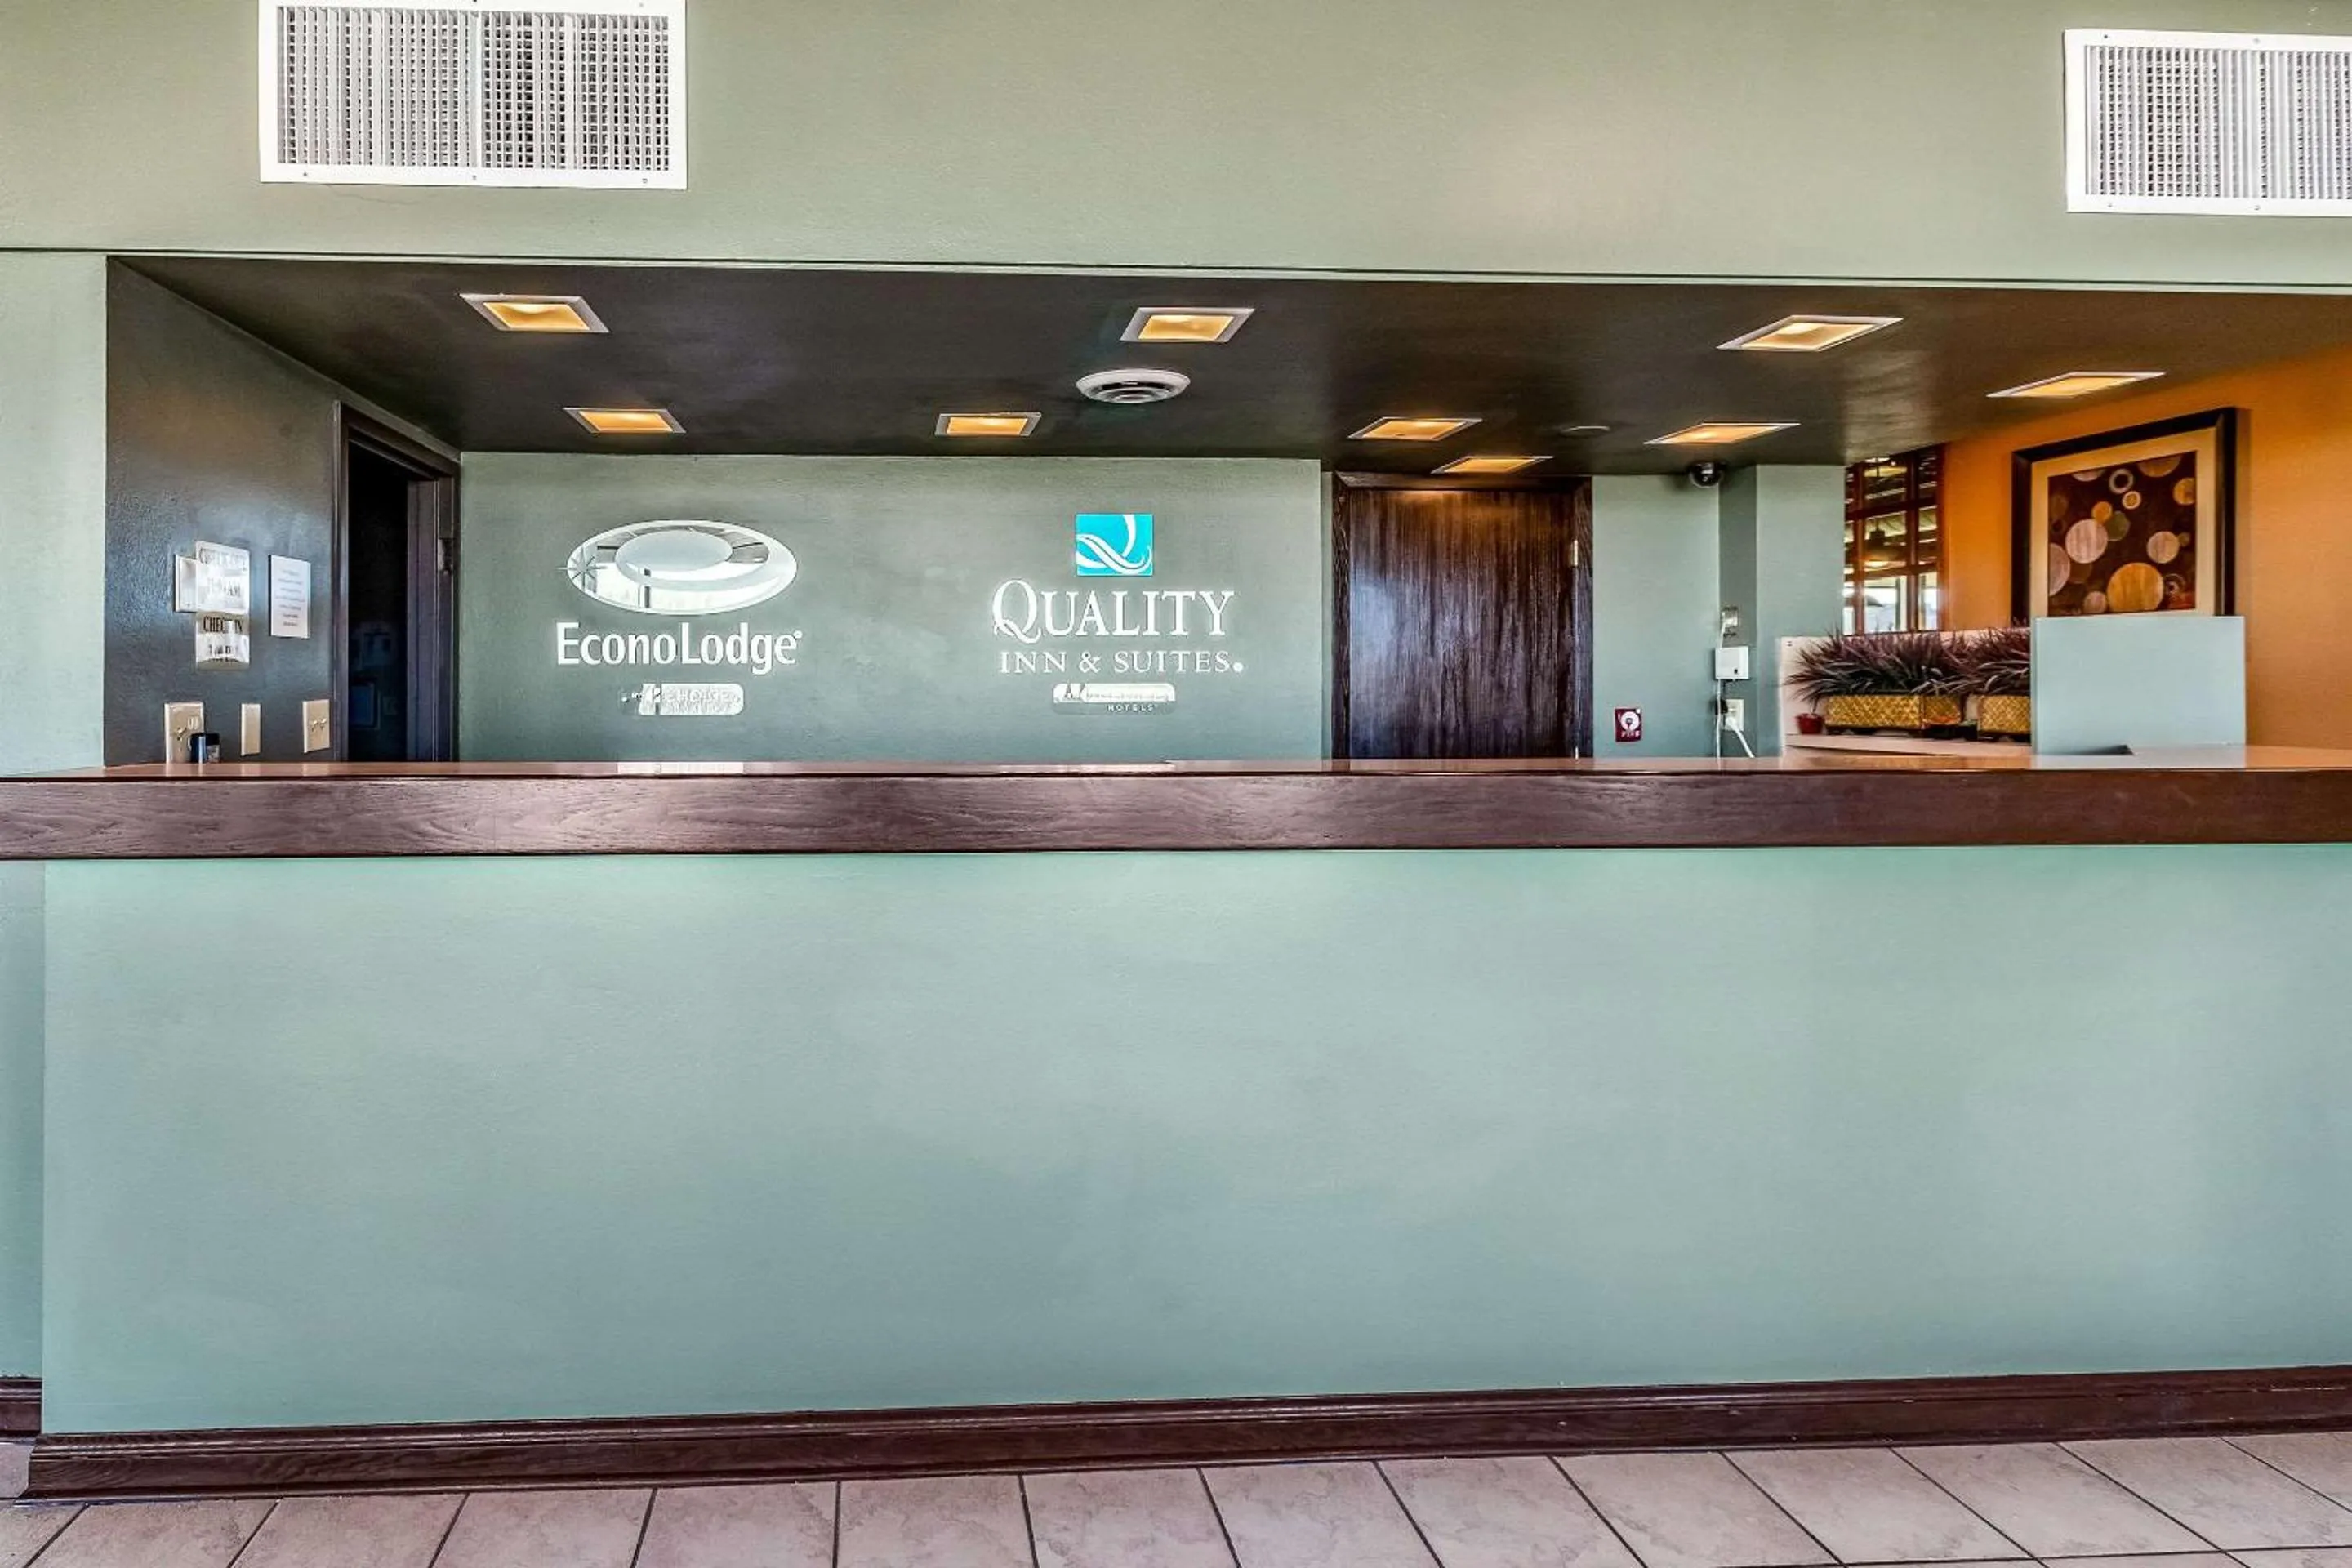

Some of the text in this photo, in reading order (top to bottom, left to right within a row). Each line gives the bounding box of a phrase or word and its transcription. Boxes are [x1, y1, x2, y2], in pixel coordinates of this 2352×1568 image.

[992, 579, 1235, 644] QUALITY
[203, 616, 233, 634] CHEC
[556, 621, 798, 675] EconoLodge
[1000, 652, 1067, 674] INN
[1078, 652, 1102, 673] &
[1107, 703, 1155, 713] HOTELS
